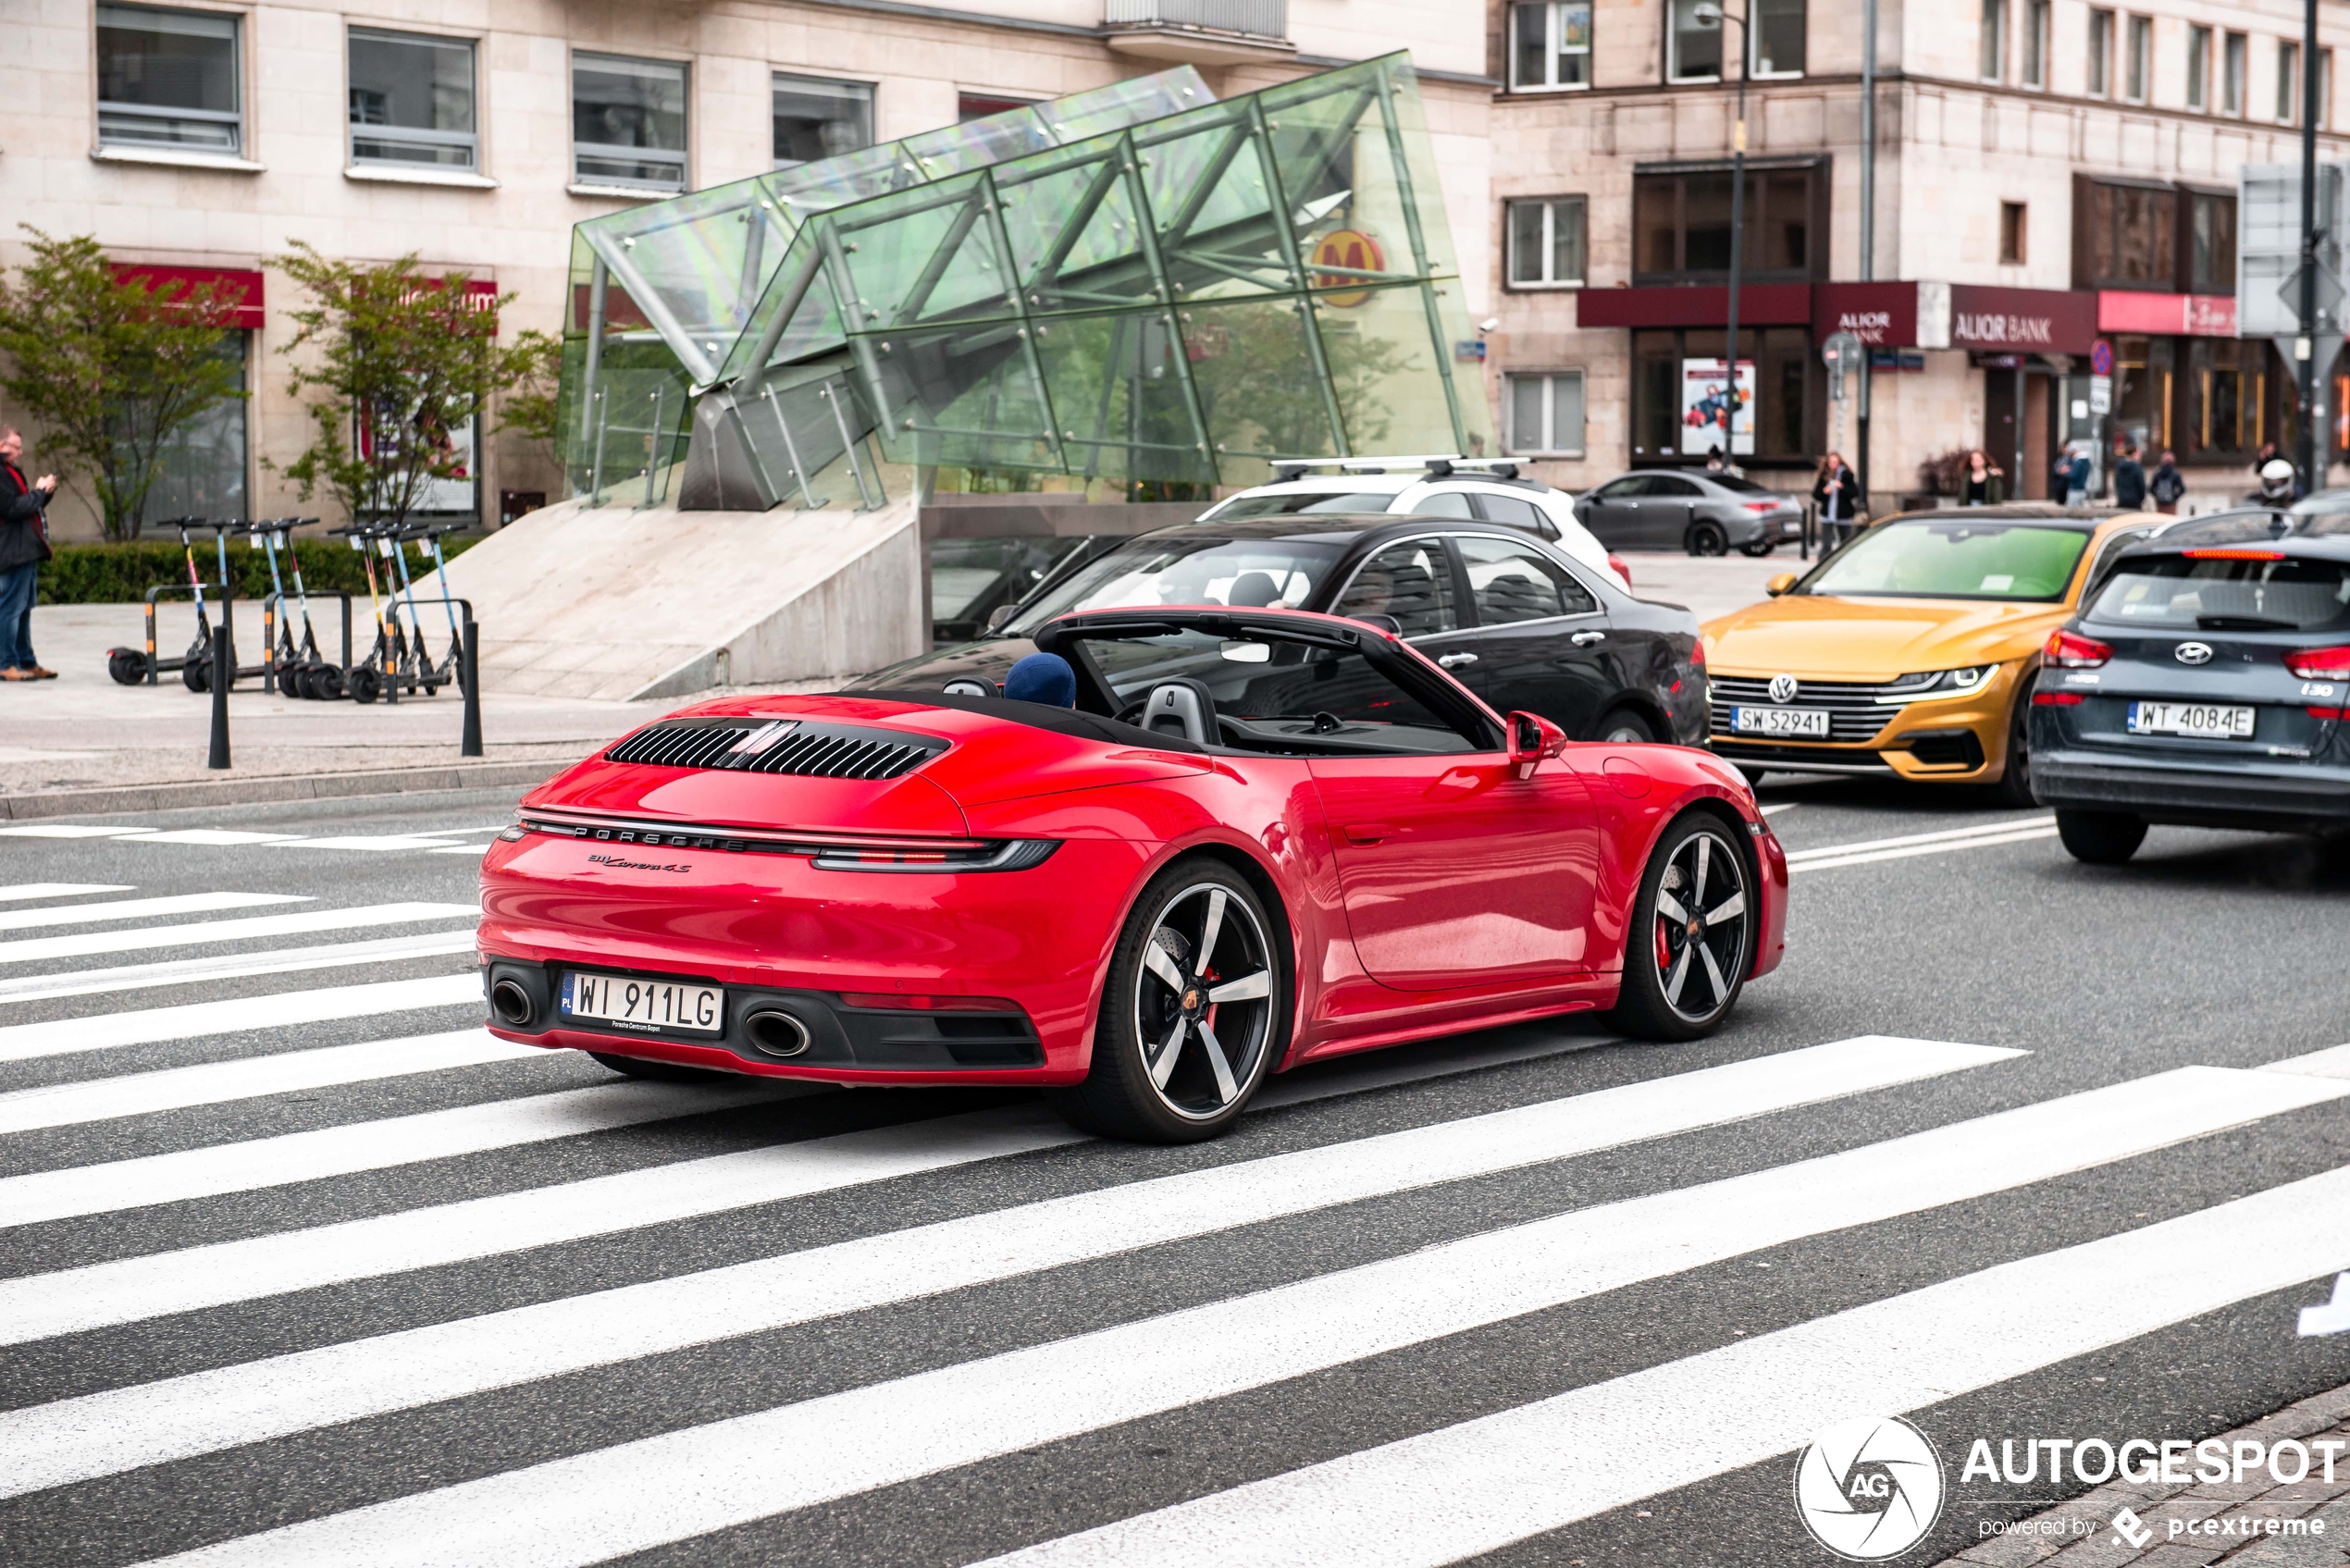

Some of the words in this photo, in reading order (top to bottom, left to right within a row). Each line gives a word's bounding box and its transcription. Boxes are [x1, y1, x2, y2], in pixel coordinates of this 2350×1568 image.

[1838, 312, 1890, 328] ALIOR
[1955, 313, 2007, 342] ALIOR
[2008, 315, 2052, 344] BANK
[2301, 683, 2333, 697] i30
[1742, 710, 1762, 729] SW
[1771, 712, 1821, 732] 52941
[2143, 705, 2171, 727] WT
[2180, 707, 2247, 732] 4084E
[574, 827, 745, 851] PORSCHE
[588, 854, 611, 863] 911
[603, 858, 661, 870] Carrera
[562, 998, 572, 1009] PL
[579, 977, 611, 1015] WI
[624, 982, 715, 1027] 911LG
[612, 1020, 629, 1029] Porsche
[629, 1022, 648, 1031] Centrum
[648, 1024, 661, 1032] Sopot
